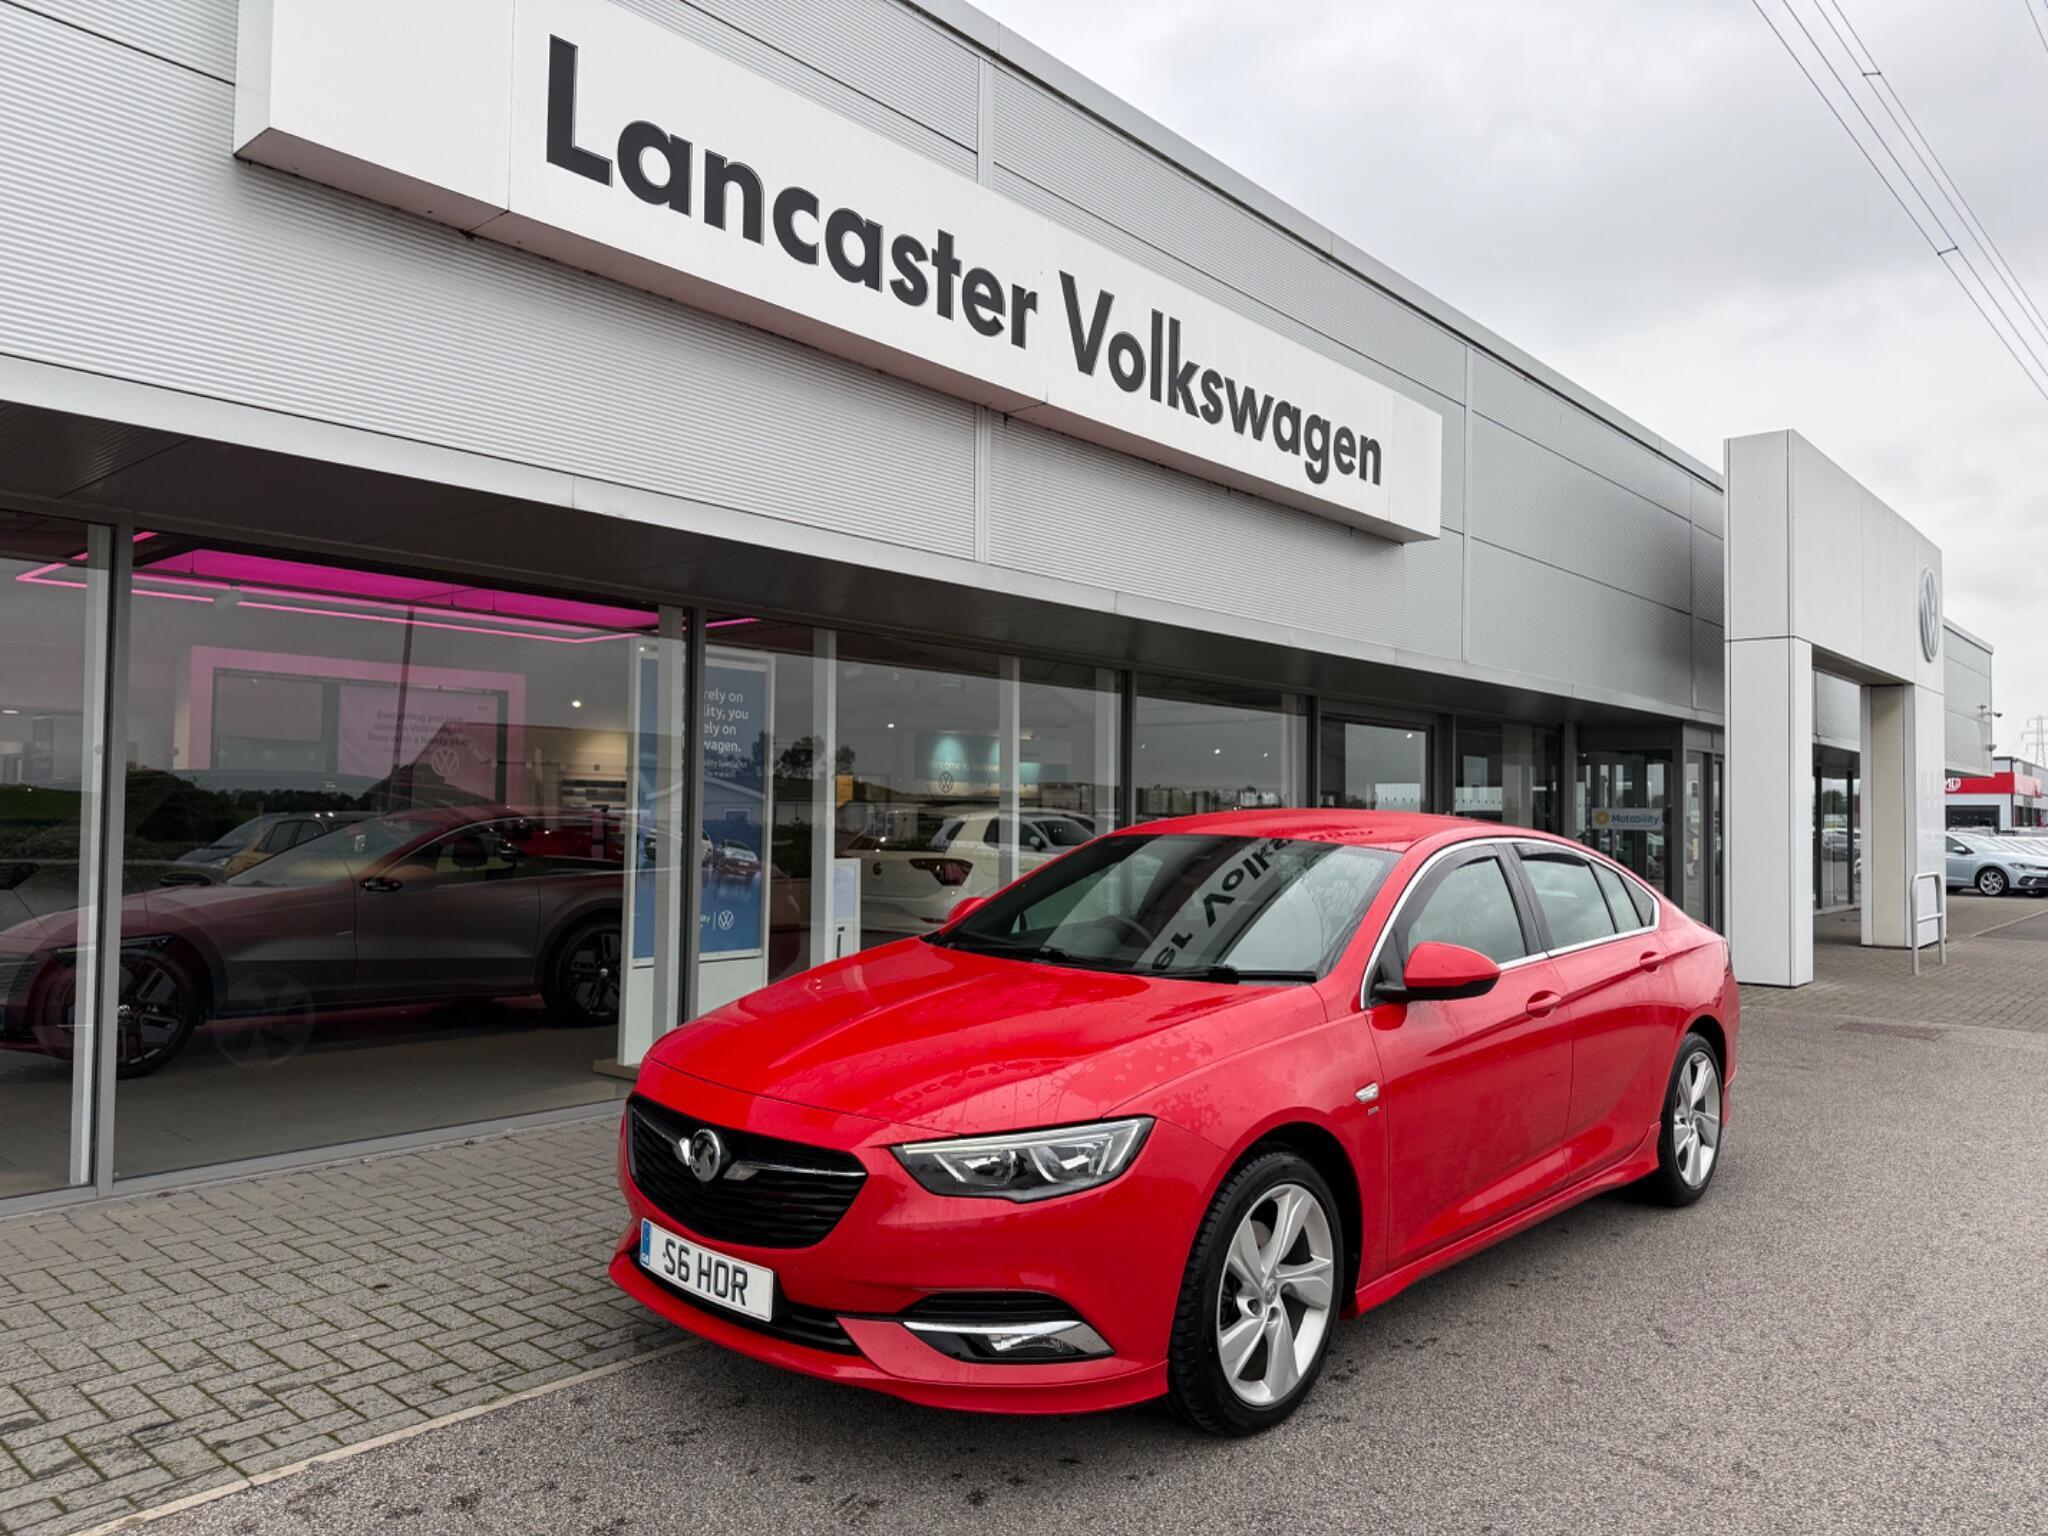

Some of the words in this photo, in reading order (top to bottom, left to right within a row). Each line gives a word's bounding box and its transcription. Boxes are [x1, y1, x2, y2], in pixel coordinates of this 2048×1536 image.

[547, 34, 1038, 350] Lancaster
[1059, 270, 1383, 486] Volkswagen
[728, 692, 744, 703] on
[727, 709, 749, 722] you
[722, 725, 737, 736] on
[1612, 814, 1659, 826] Motability
[664, 1238, 690, 1283] S6
[697, 1253, 748, 1306] HOR
